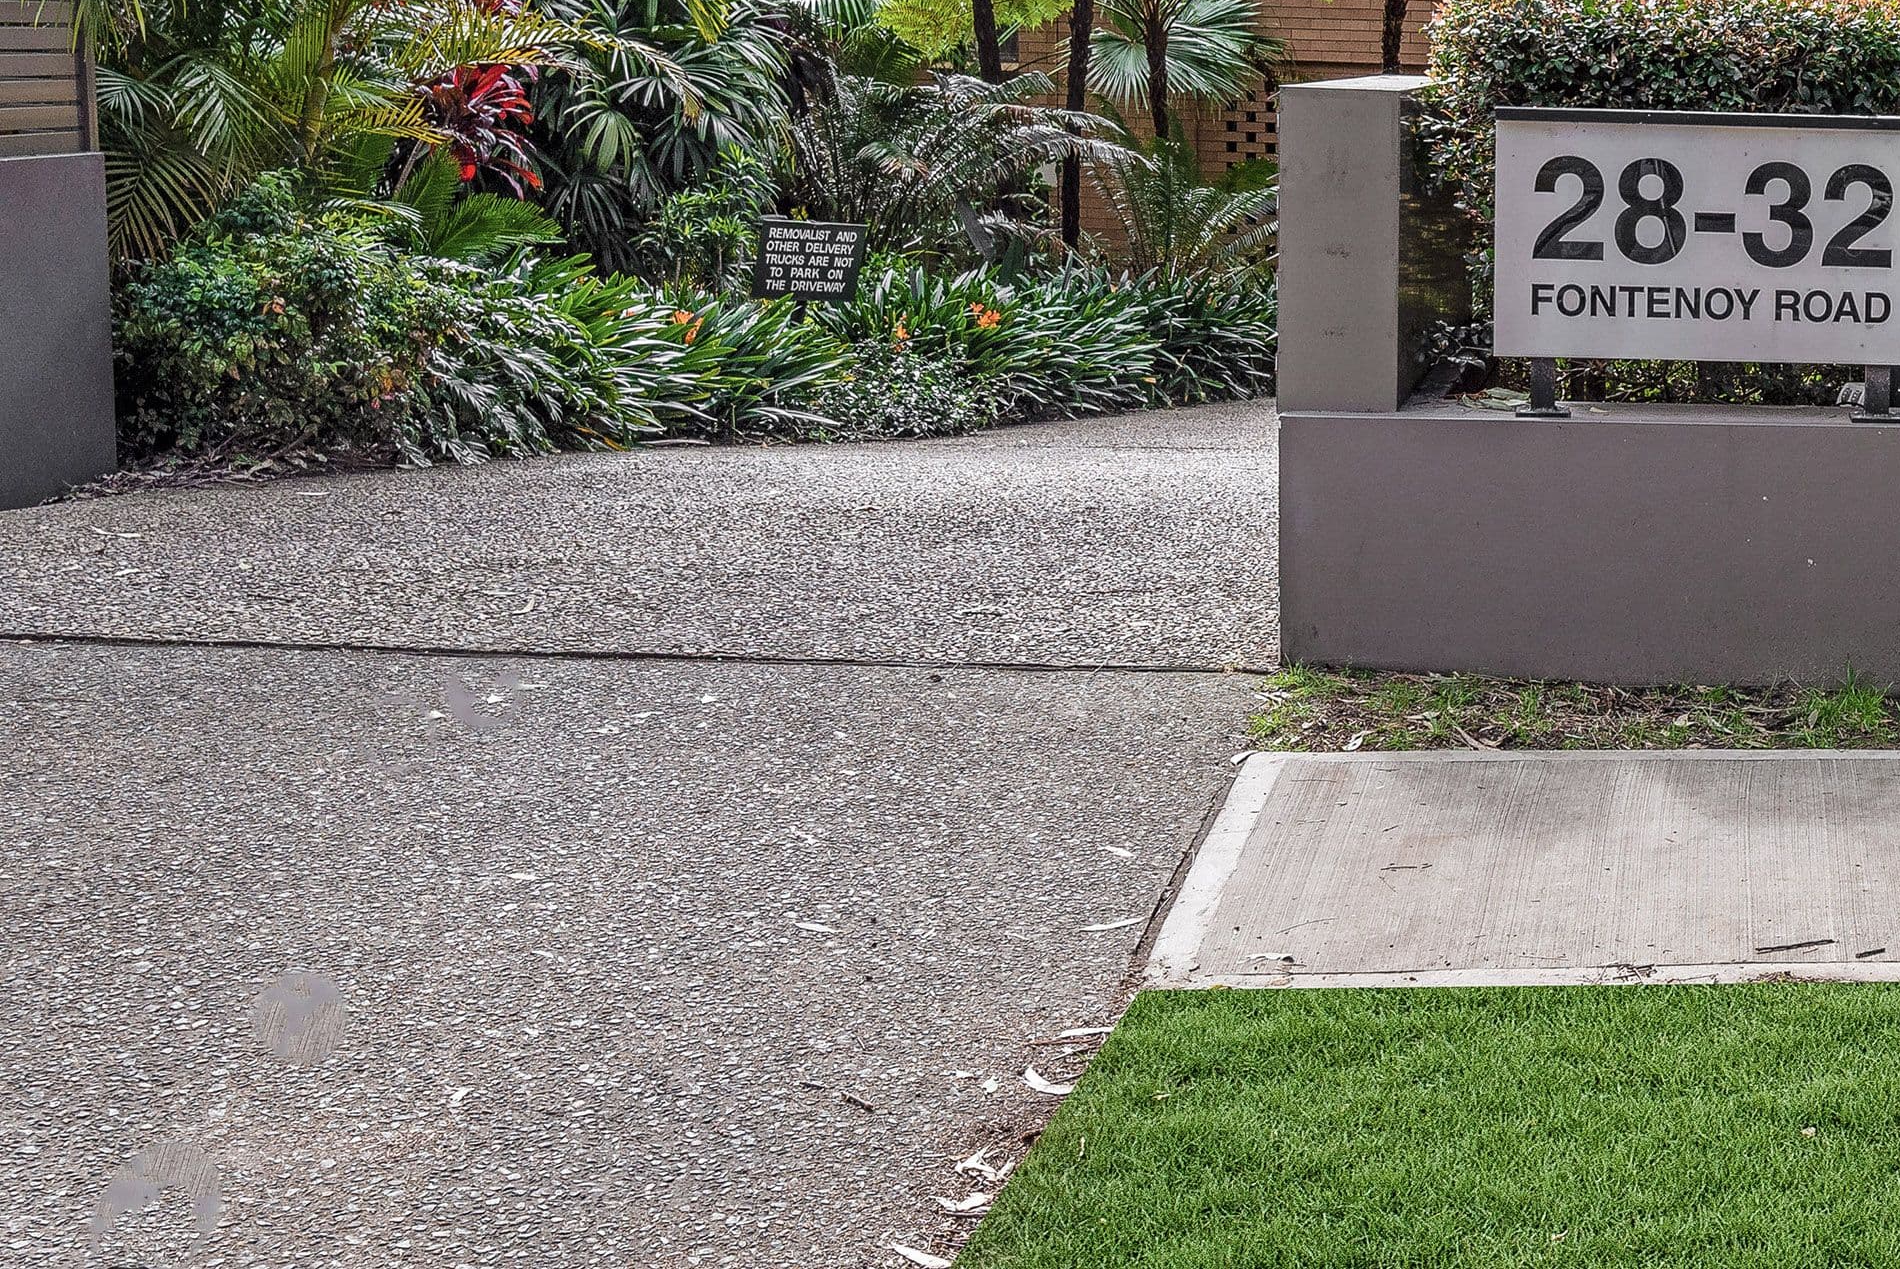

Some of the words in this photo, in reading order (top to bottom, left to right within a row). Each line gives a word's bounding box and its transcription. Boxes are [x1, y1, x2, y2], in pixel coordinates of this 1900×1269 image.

[1533, 155, 1893, 268] 28-32
[769, 228, 830, 241] REMOVALIST
[836, 232, 857, 242] AND
[766, 241, 799, 252] OTHER
[806, 243, 854, 255] DELIVERY
[765, 254, 804, 265] TRUCKS
[808, 256, 829, 266] ARE
[834, 258, 854, 268] NOT
[770, 267, 783, 277] TO
[790, 268, 819, 279] PARK
[828, 270, 843, 280] ON
[766, 280, 785, 290] THE
[791, 281, 845, 293] DRIVEWAY
[1531, 284, 1760, 320] FONTENOY
[1775, 289, 1891, 323] ROAD
